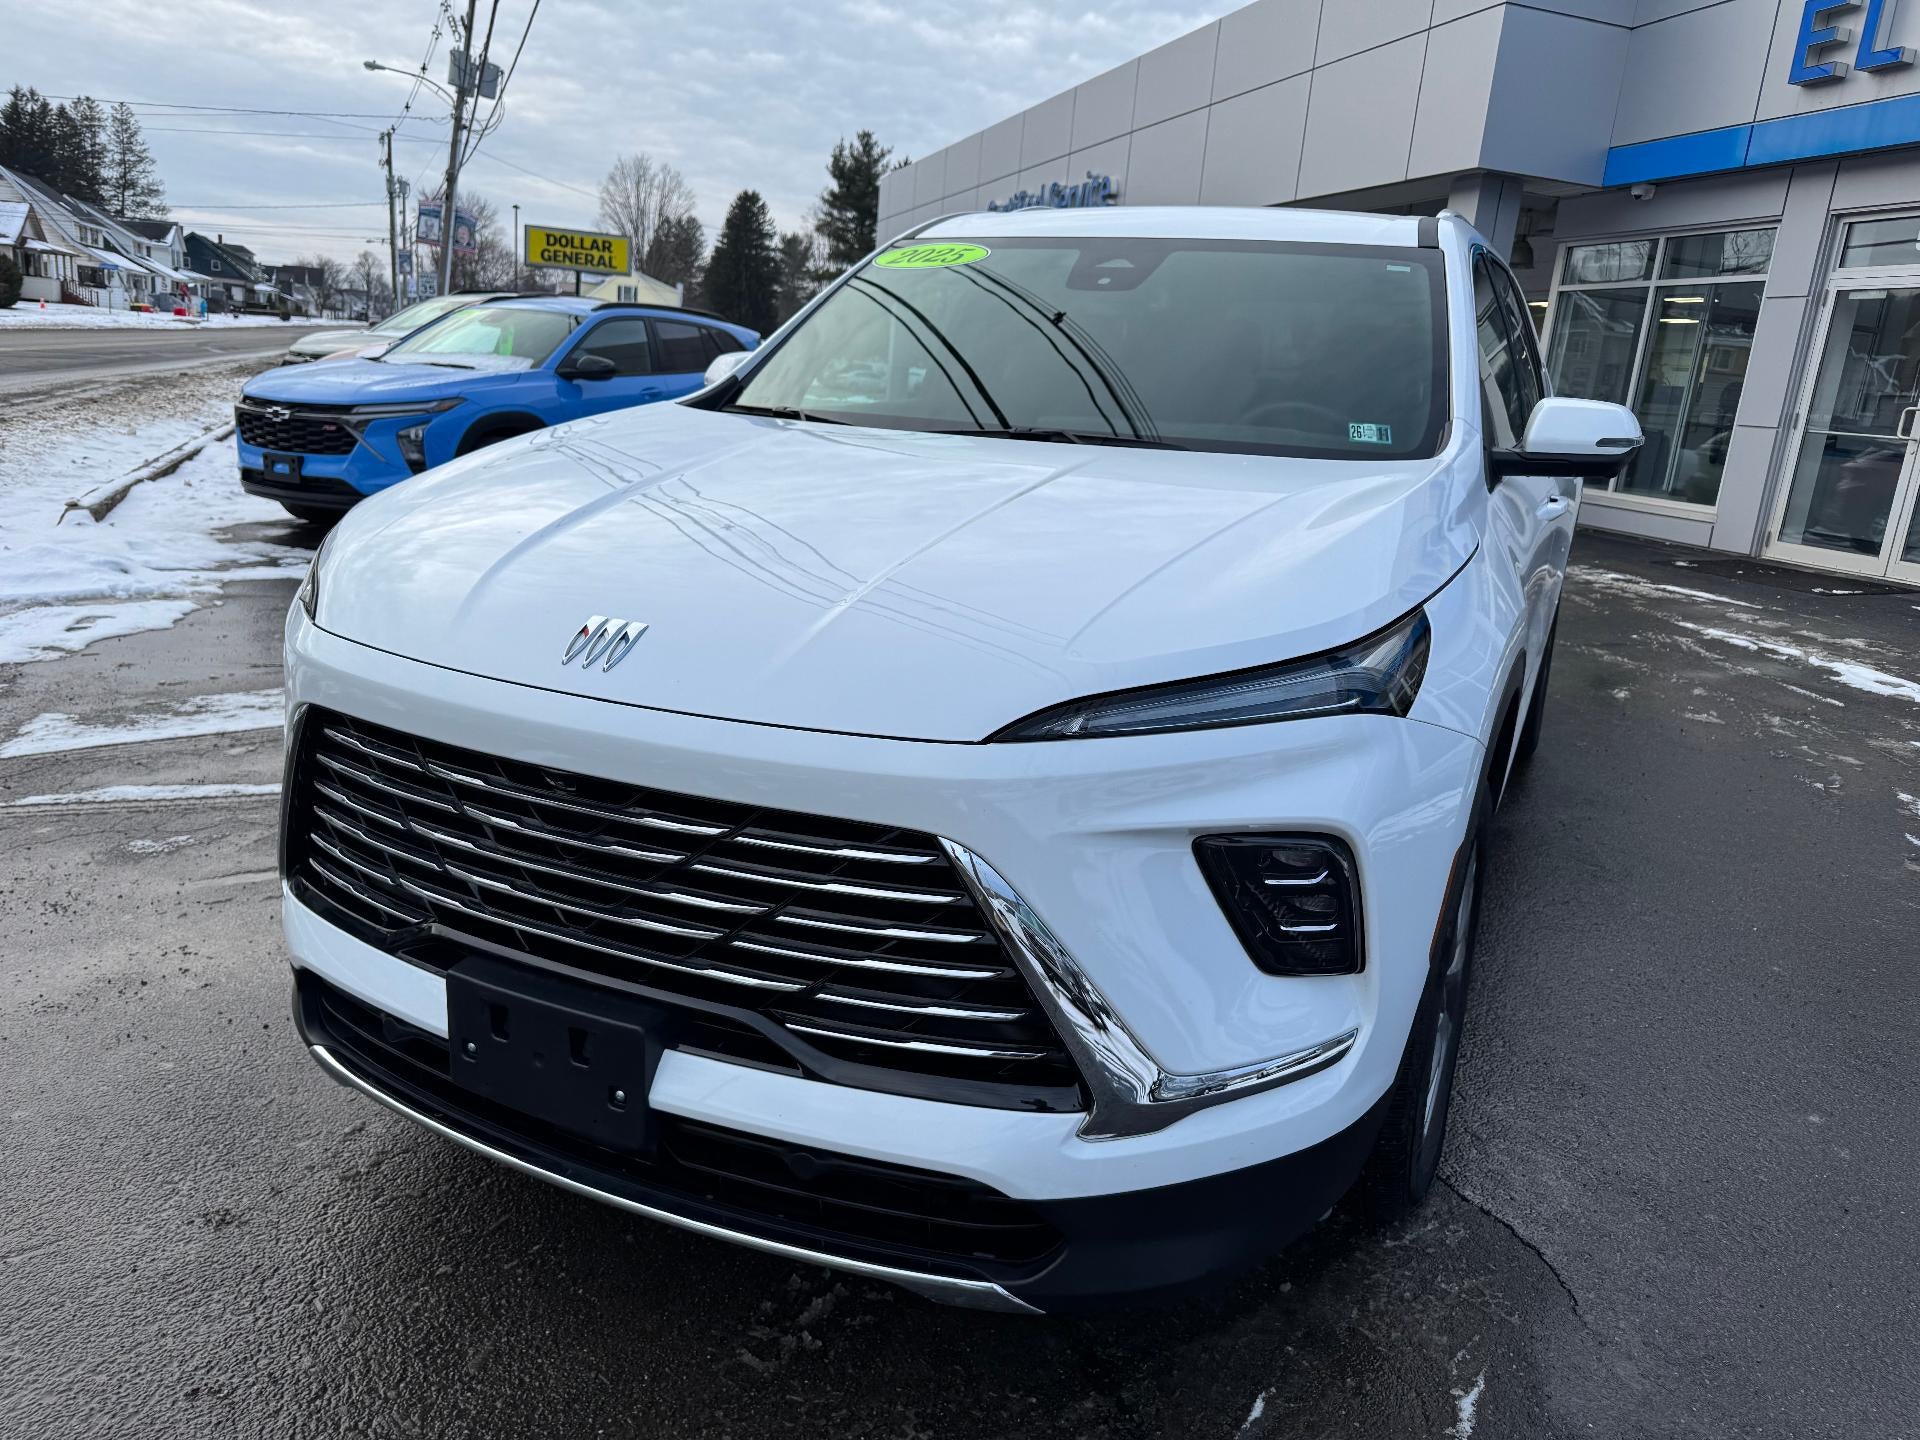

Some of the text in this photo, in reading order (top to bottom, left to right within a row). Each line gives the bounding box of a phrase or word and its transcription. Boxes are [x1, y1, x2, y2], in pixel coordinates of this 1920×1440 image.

[546, 232, 612, 253] DOLLAR
[541, 249, 617, 269] GENERAL
[886, 248, 976, 265] 2025
[1351, 425, 1362, 439] 26
[1376, 426, 1390, 441] 11
